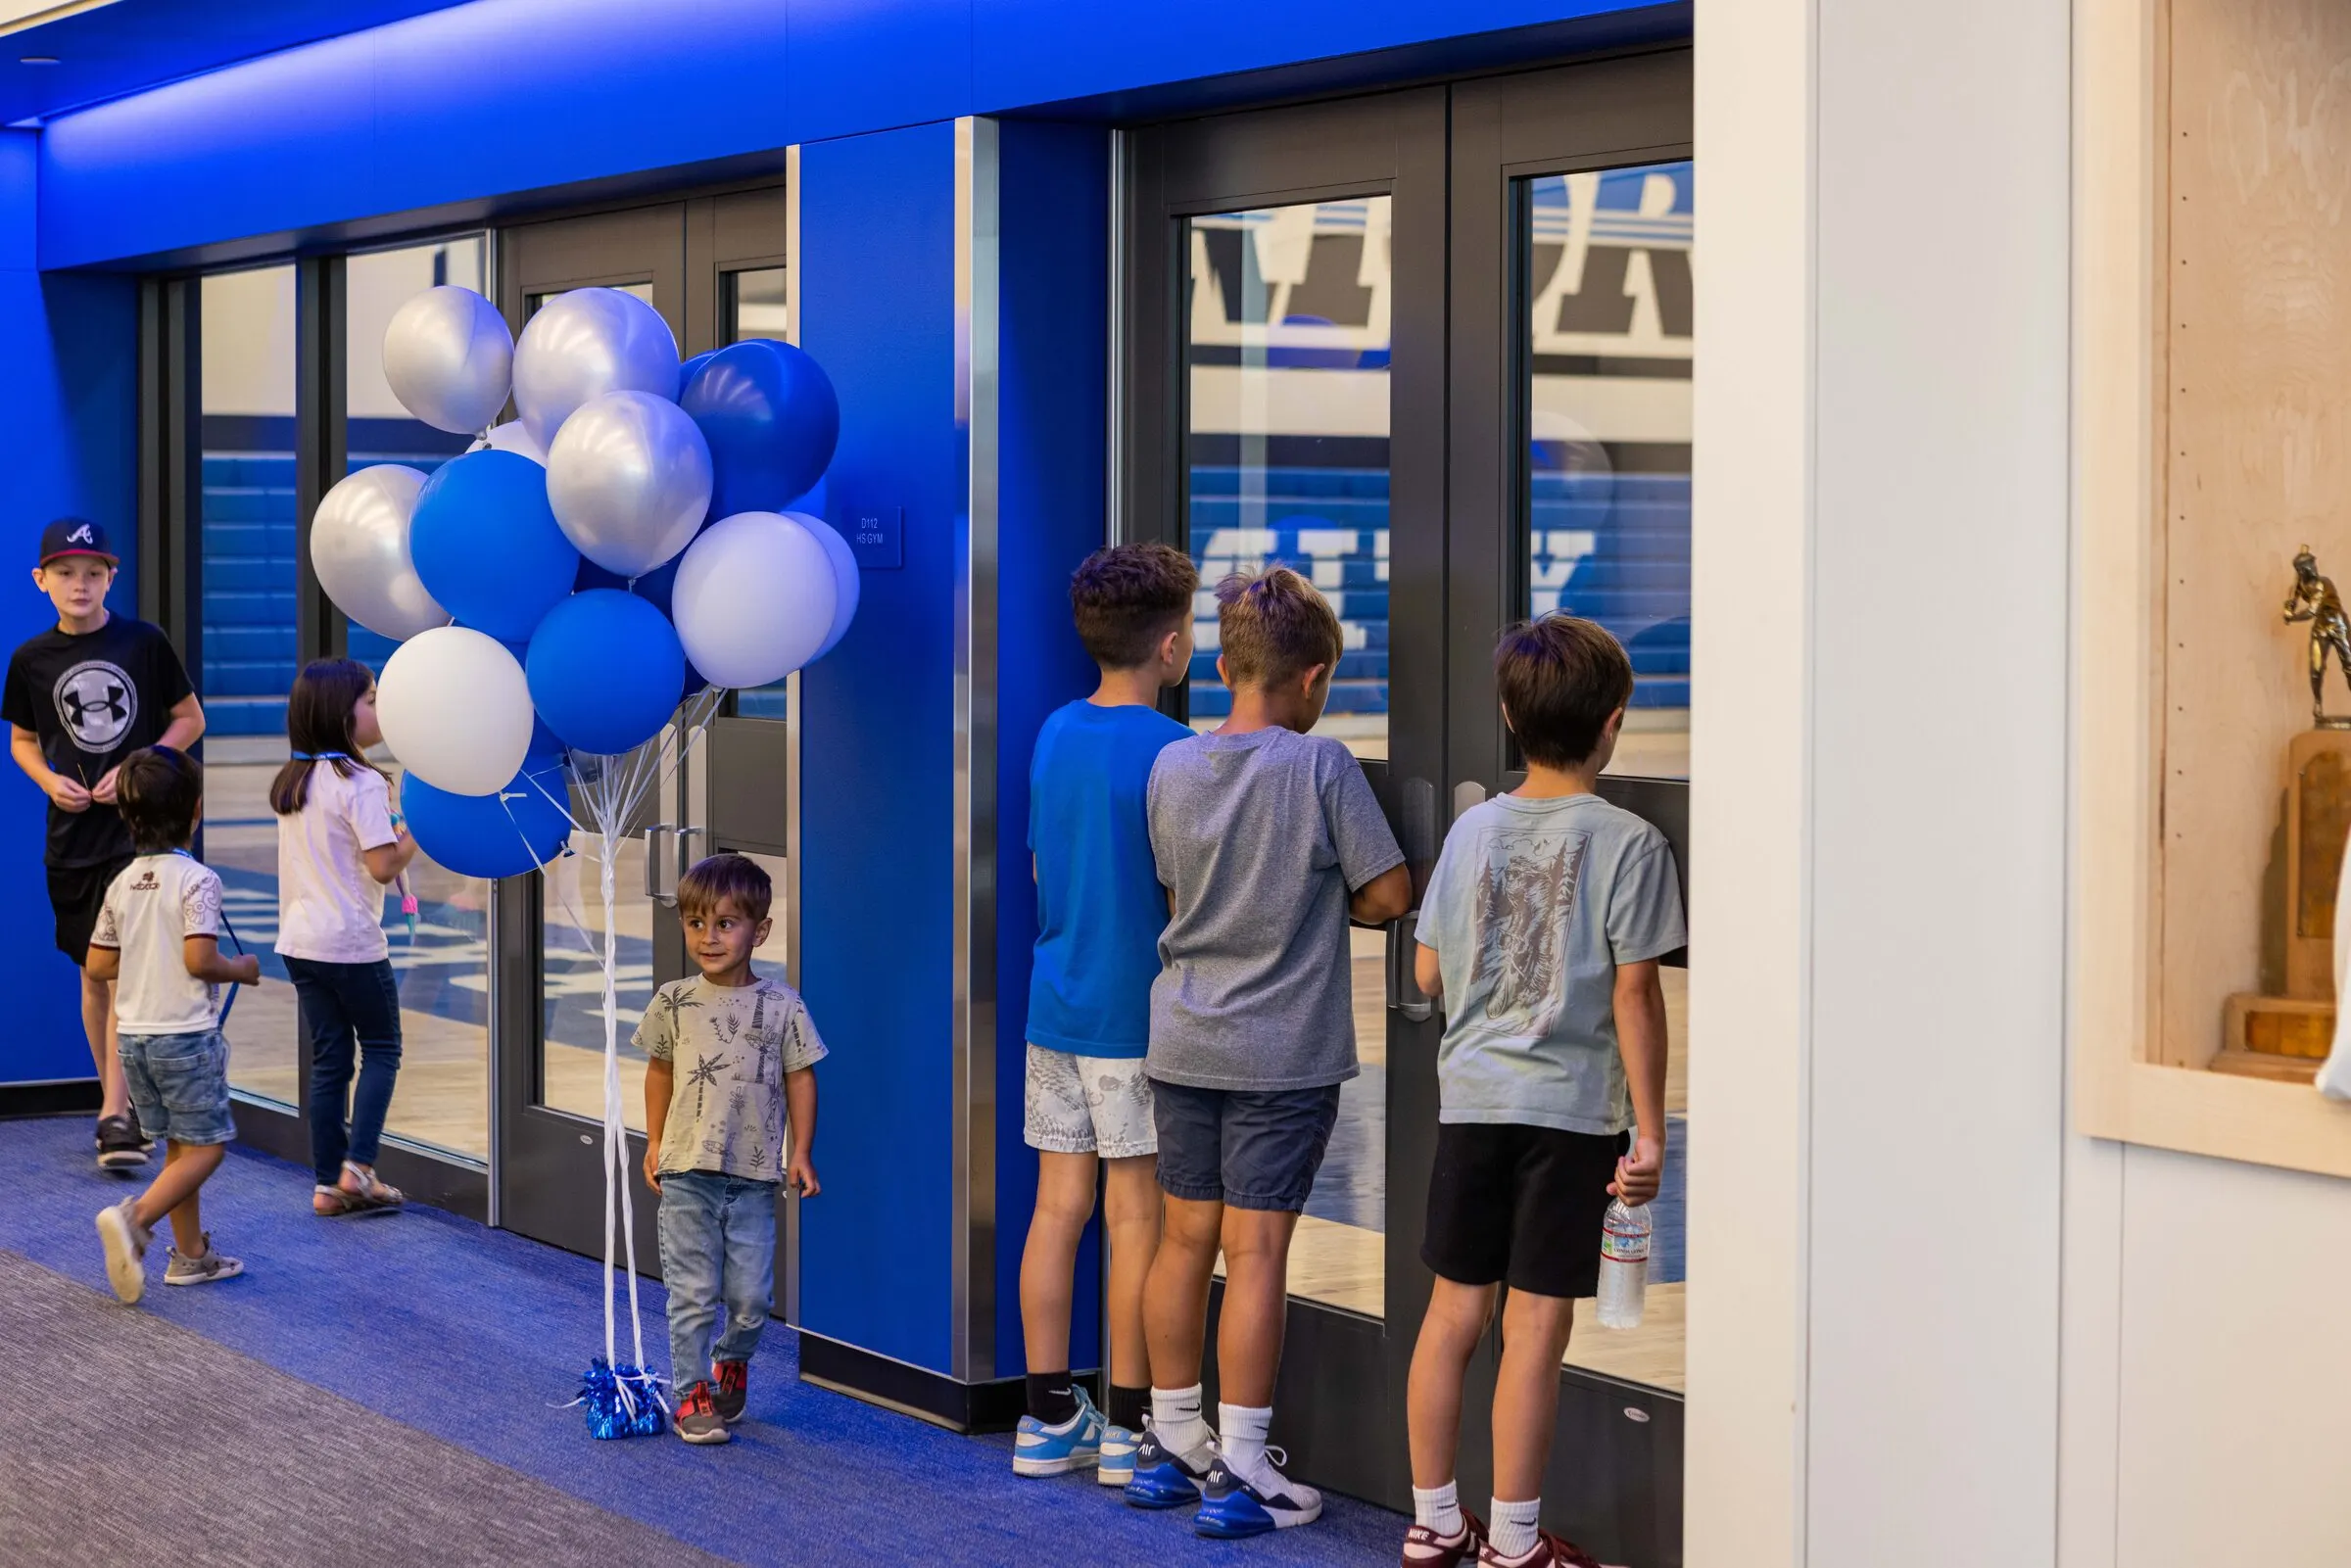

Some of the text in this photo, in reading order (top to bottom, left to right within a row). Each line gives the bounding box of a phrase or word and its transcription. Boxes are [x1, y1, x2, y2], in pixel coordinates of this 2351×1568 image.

[861, 517, 878, 529] D112
[66, 523, 93, 545] A
[856, 533, 884, 545] HS GYM
[1408, 1528, 1430, 1542] NIKE
